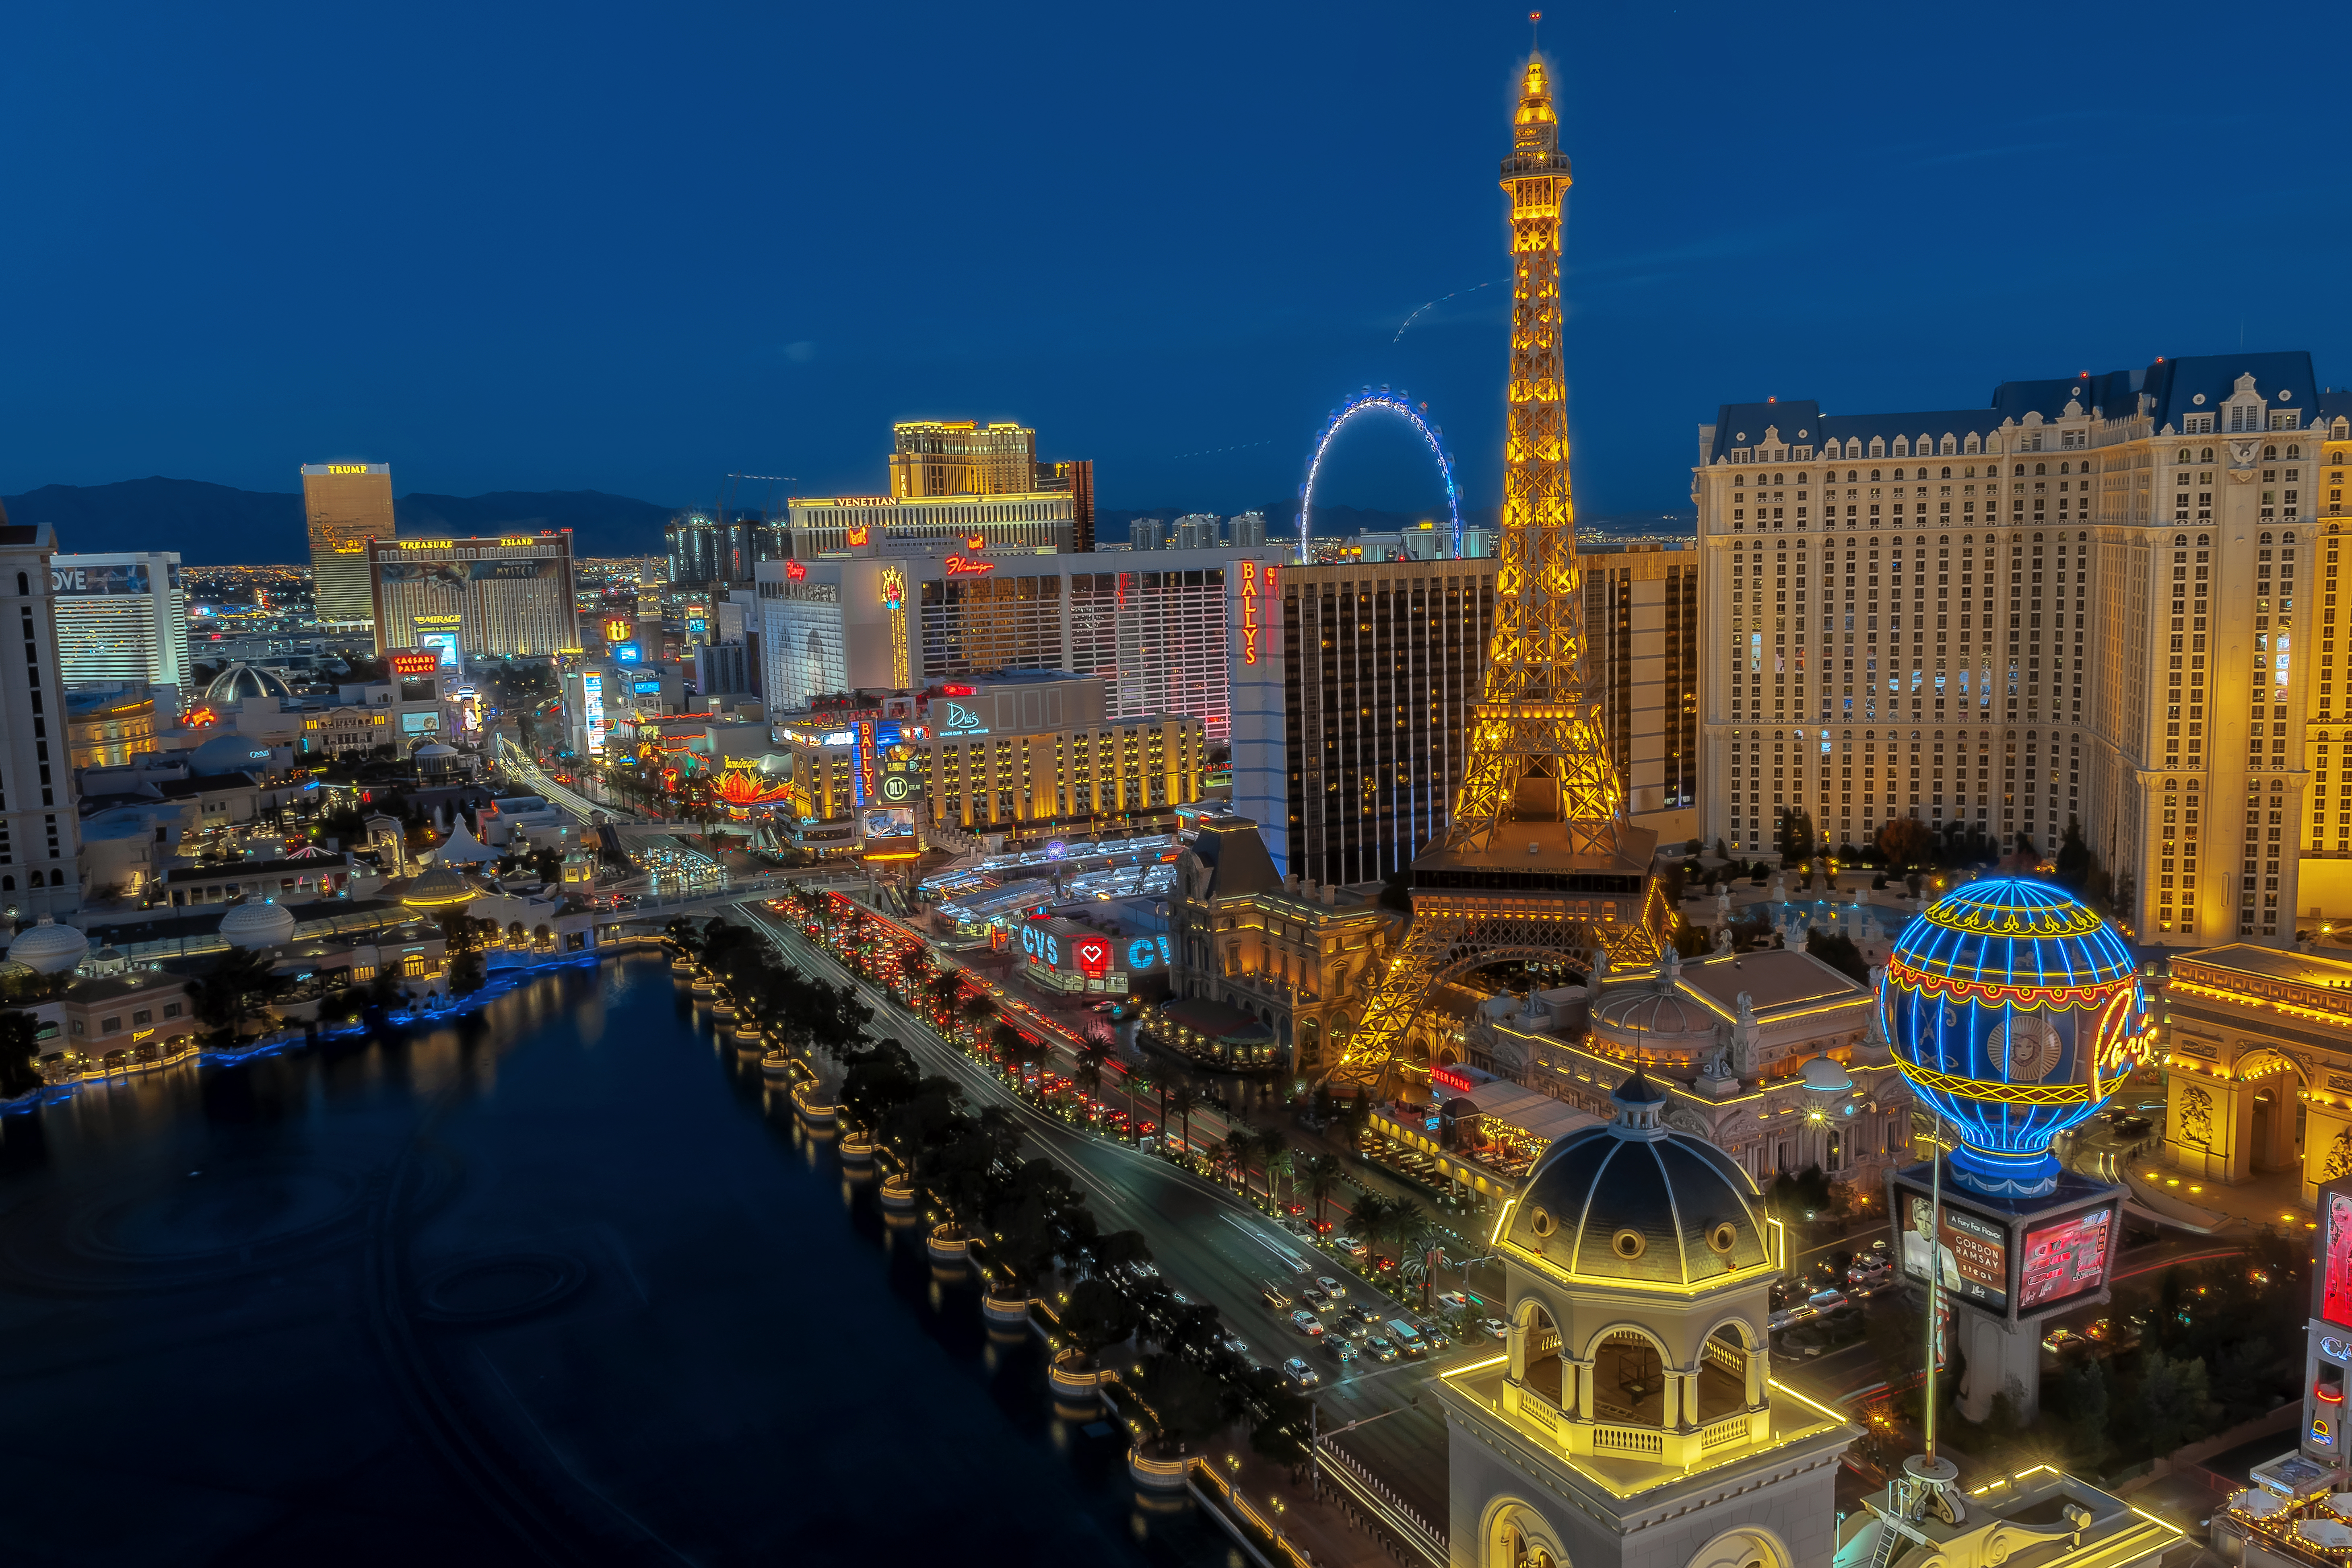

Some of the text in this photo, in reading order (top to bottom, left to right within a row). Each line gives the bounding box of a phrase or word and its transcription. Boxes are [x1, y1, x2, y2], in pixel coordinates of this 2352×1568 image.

[328, 465, 367, 474] TRUMP
[837, 497, 897, 507] VENETIAN
[400, 538, 533, 550] TREASURE ISLAND
[946, 557, 994, 575] Flamingo
[52, 571, 87, 590] OVE
[417, 614, 462, 624] MIRAGE
[1241, 563, 1257, 664] BALLYS
[610, 620, 625, 640] ti
[394, 656, 435, 664] CAESARS
[398, 664, 434, 673] PALACE
[861, 723, 874, 797] BALLYS
[889, 781, 902, 795] BLT
[1022, 925, 1058, 964] CVS
[2094, 987, 2158, 1103] Paris
[1431, 1068, 1469, 1092] BEER PARK
[1956, 1236, 1999, 1259] GORDON
[1956, 1246, 1998, 1269] RAMSAY
